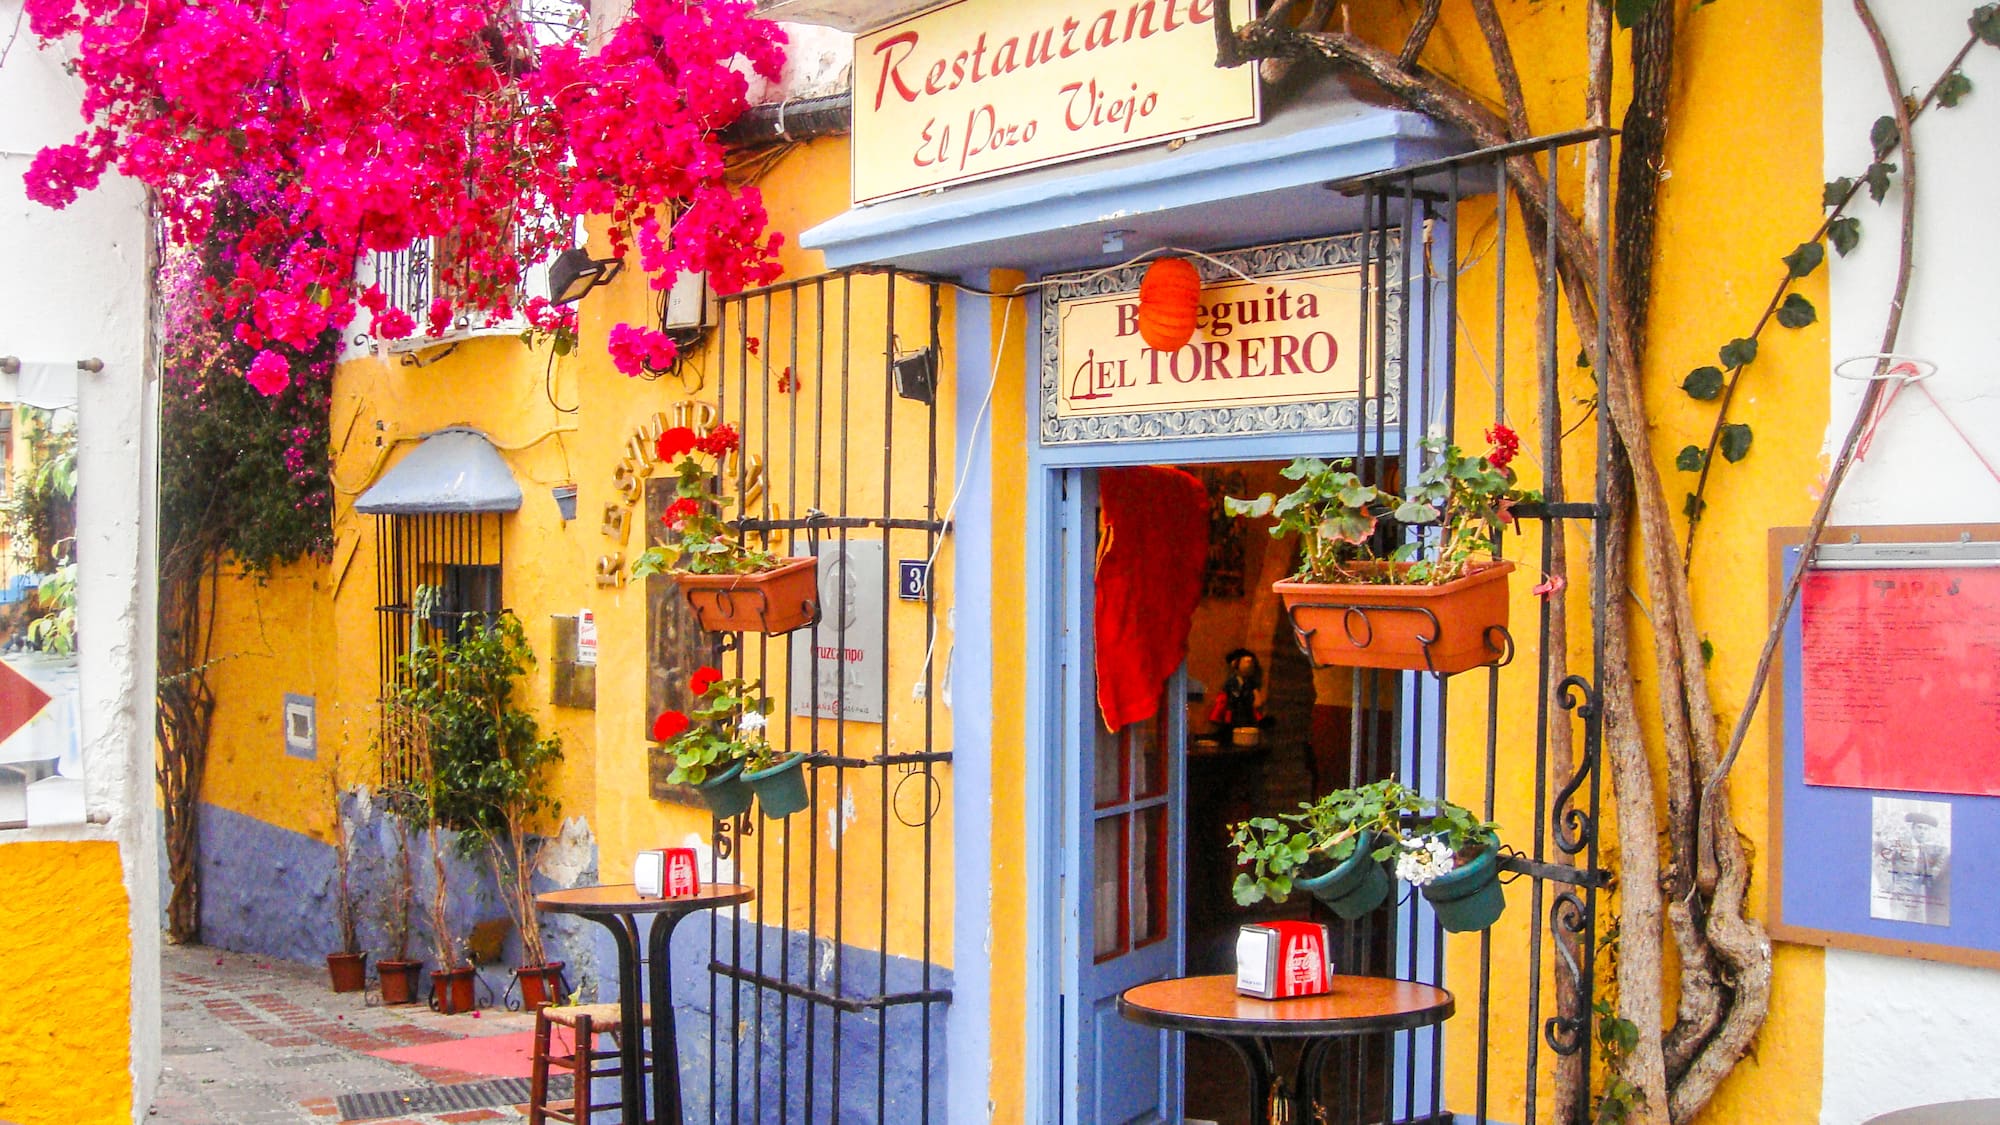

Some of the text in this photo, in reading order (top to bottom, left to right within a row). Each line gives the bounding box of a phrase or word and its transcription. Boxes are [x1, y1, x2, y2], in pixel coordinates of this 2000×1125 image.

[873, 0, 1215, 113] Restaurante
[913, 77, 1159, 171] El Pozo Viejo
[1114, 286, 1320, 338] Beguita
[1096, 330, 1339, 390] EL TORERO
[909, 567, 922, 594] 3
[810, 645, 865, 665] ruzcmpo
